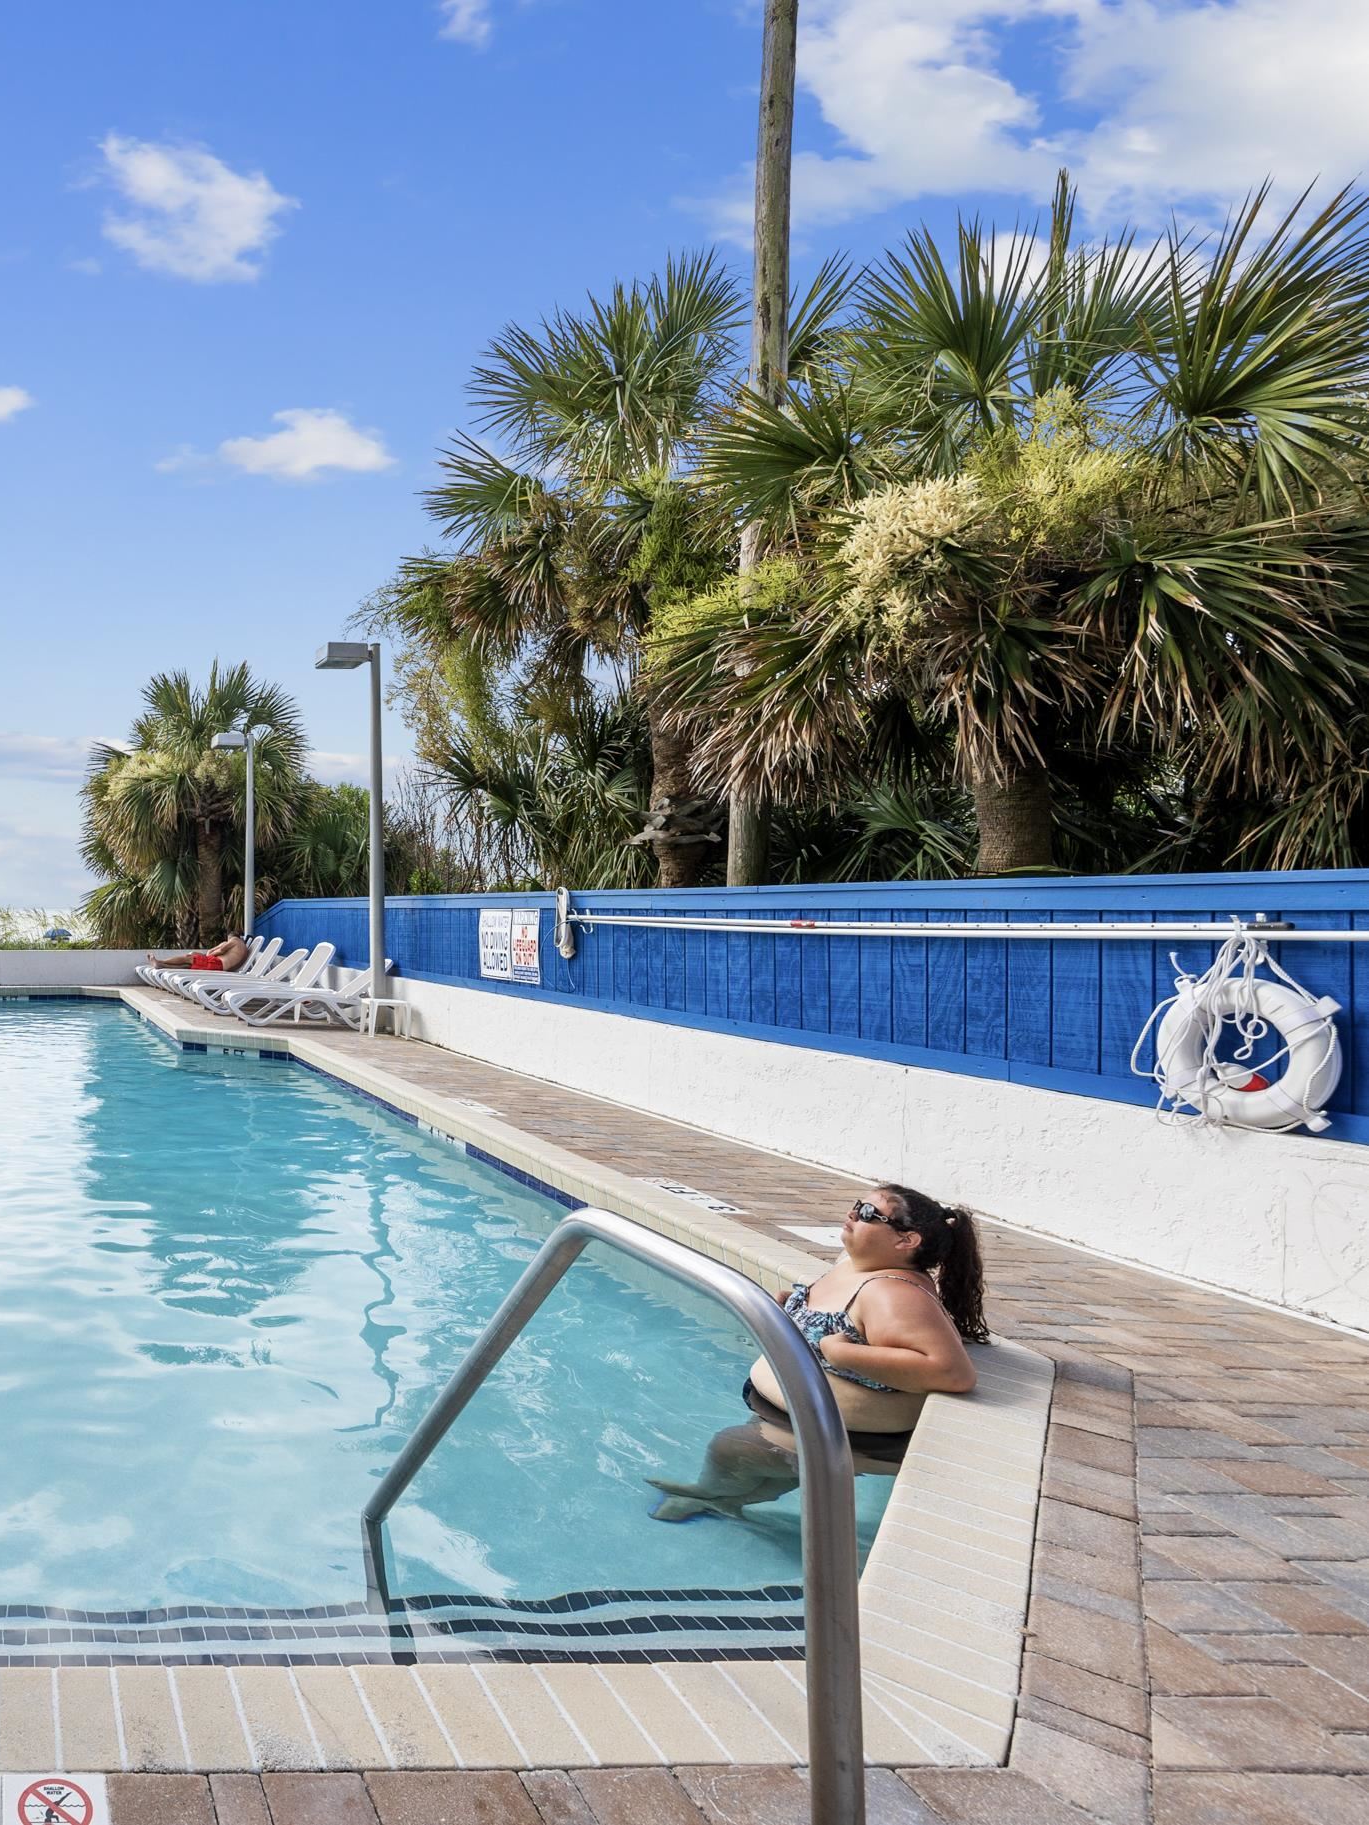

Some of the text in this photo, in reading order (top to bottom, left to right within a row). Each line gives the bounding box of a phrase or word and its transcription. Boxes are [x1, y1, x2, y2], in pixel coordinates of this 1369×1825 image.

[481, 931, 508, 950] NO DIVING
[483, 951, 508, 971] ALLOWED
